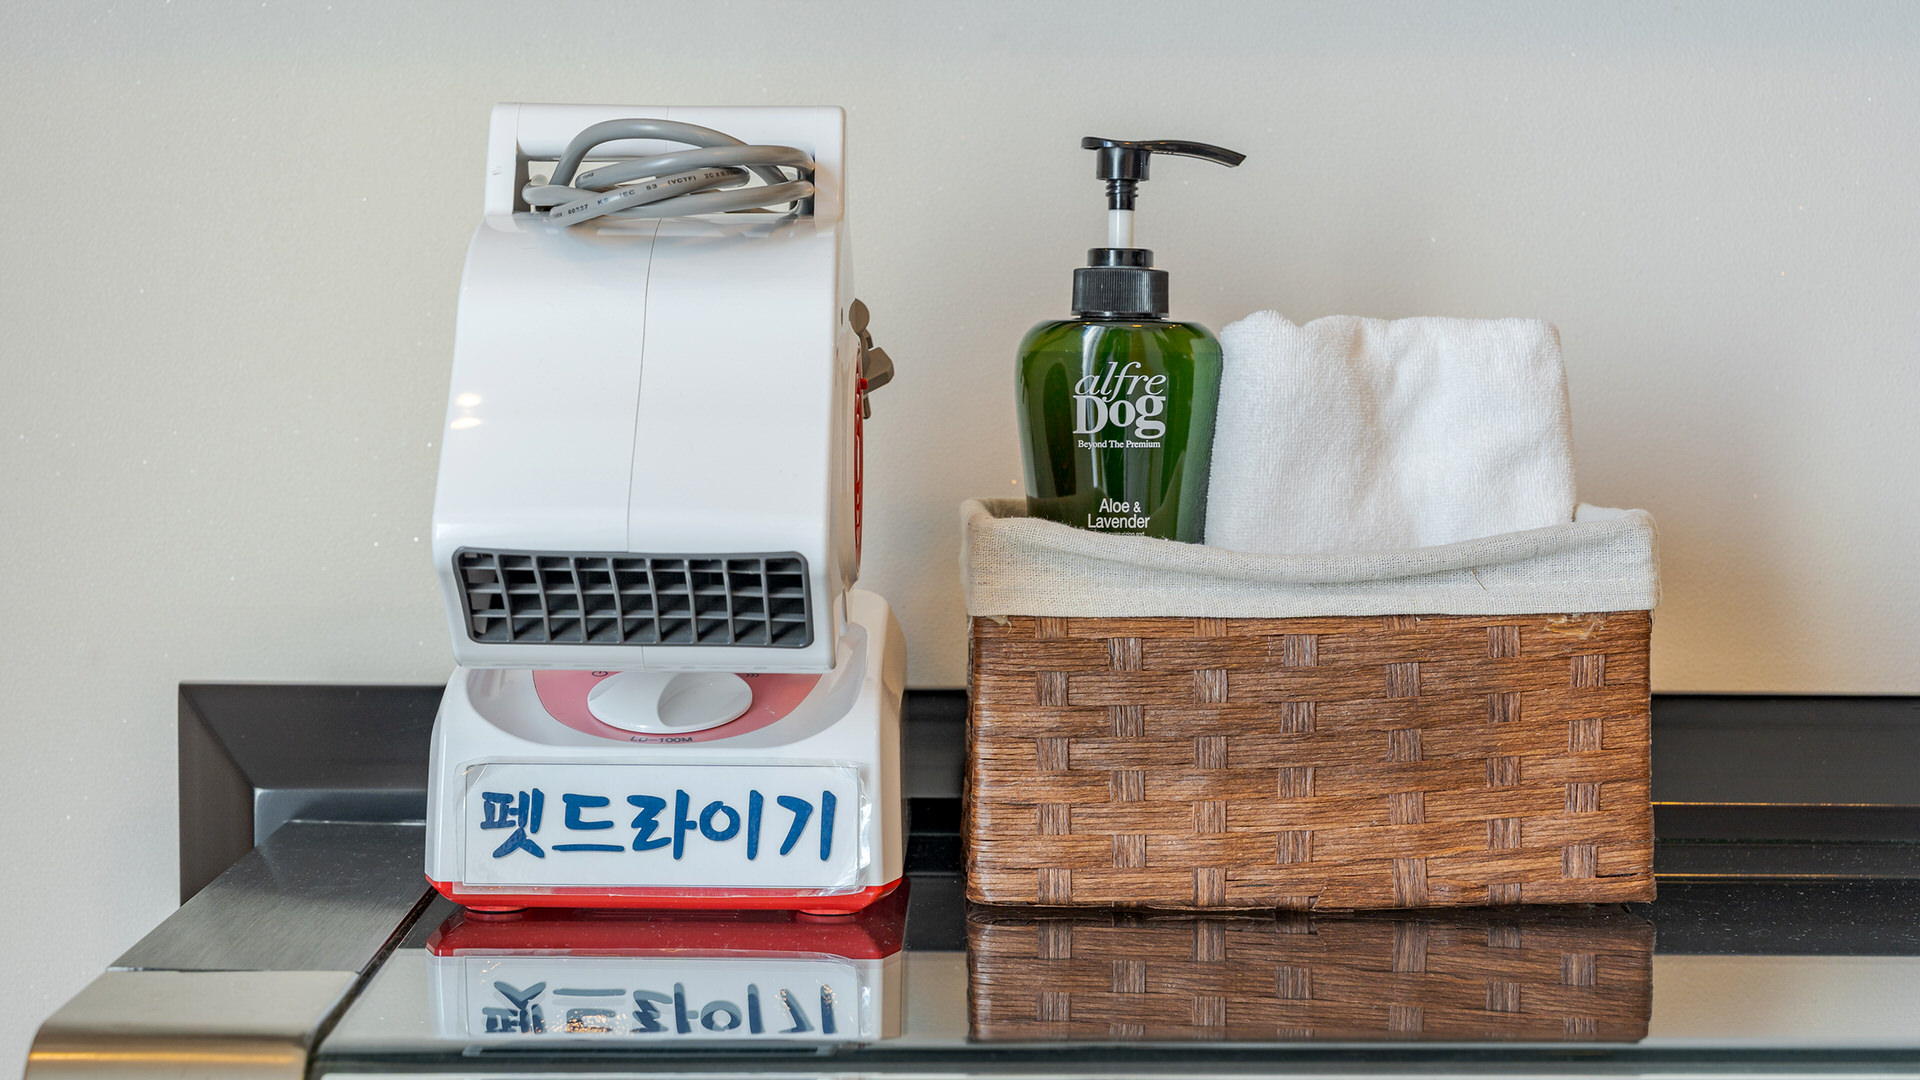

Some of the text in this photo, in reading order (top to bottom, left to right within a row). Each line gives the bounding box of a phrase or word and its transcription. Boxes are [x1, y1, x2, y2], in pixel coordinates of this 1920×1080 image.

[1074, 361, 1167, 403] alfre
[1073, 395, 1166, 439] Dog
[1077, 440, 1161, 450] Beyond The Premium
[1098, 497, 1142, 514] Aloe &
[1087, 513, 1150, 529] Lavender
[480, 787, 838, 862] 펫드라이기
